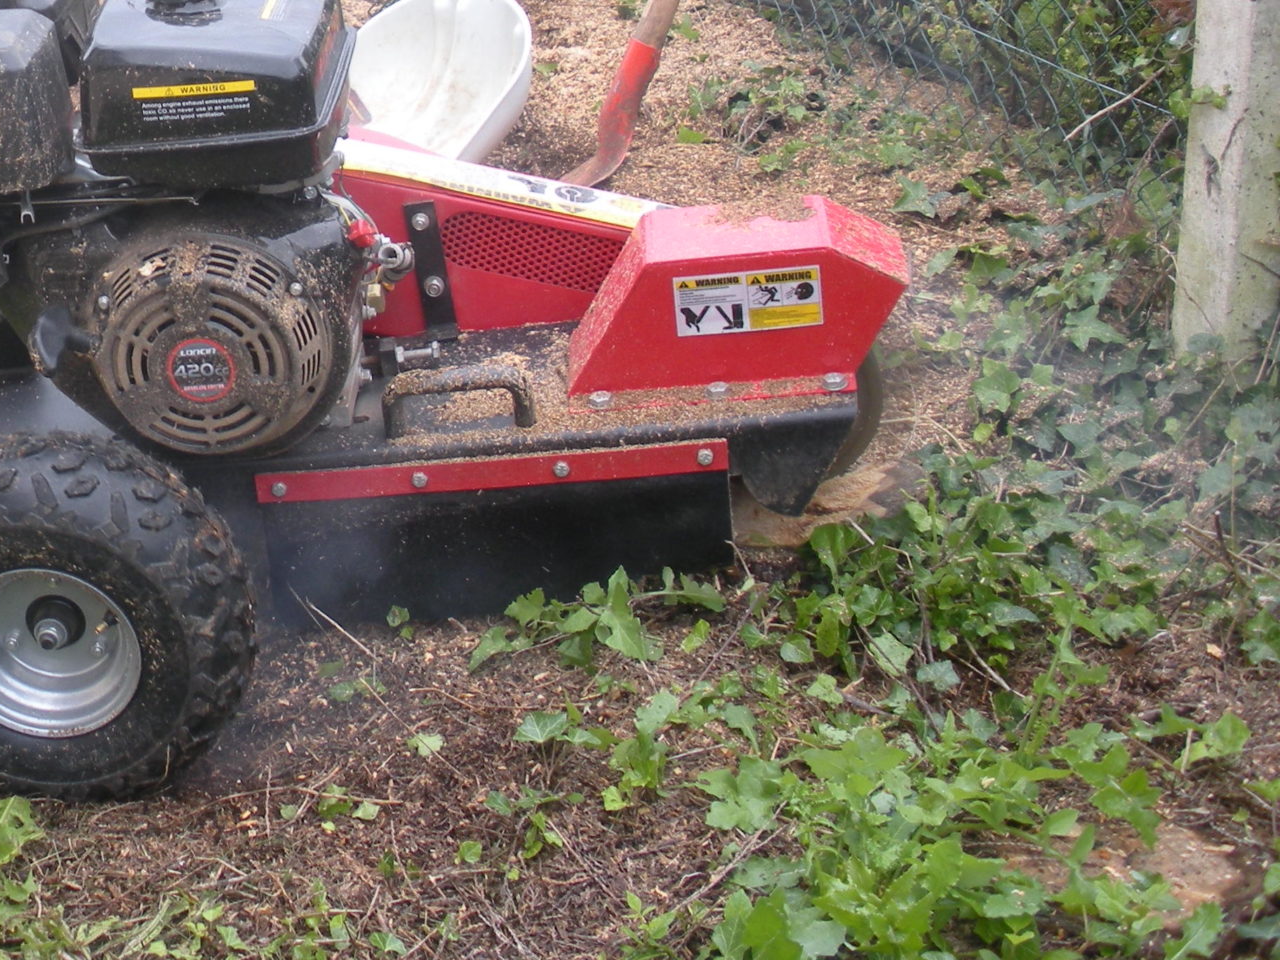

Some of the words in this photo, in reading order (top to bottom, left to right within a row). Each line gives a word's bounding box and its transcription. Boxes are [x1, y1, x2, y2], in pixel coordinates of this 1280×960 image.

[180, 83, 226, 94] WARNING
[695, 276, 740, 287] WARNING
[764, 271, 812, 283] WARNING
